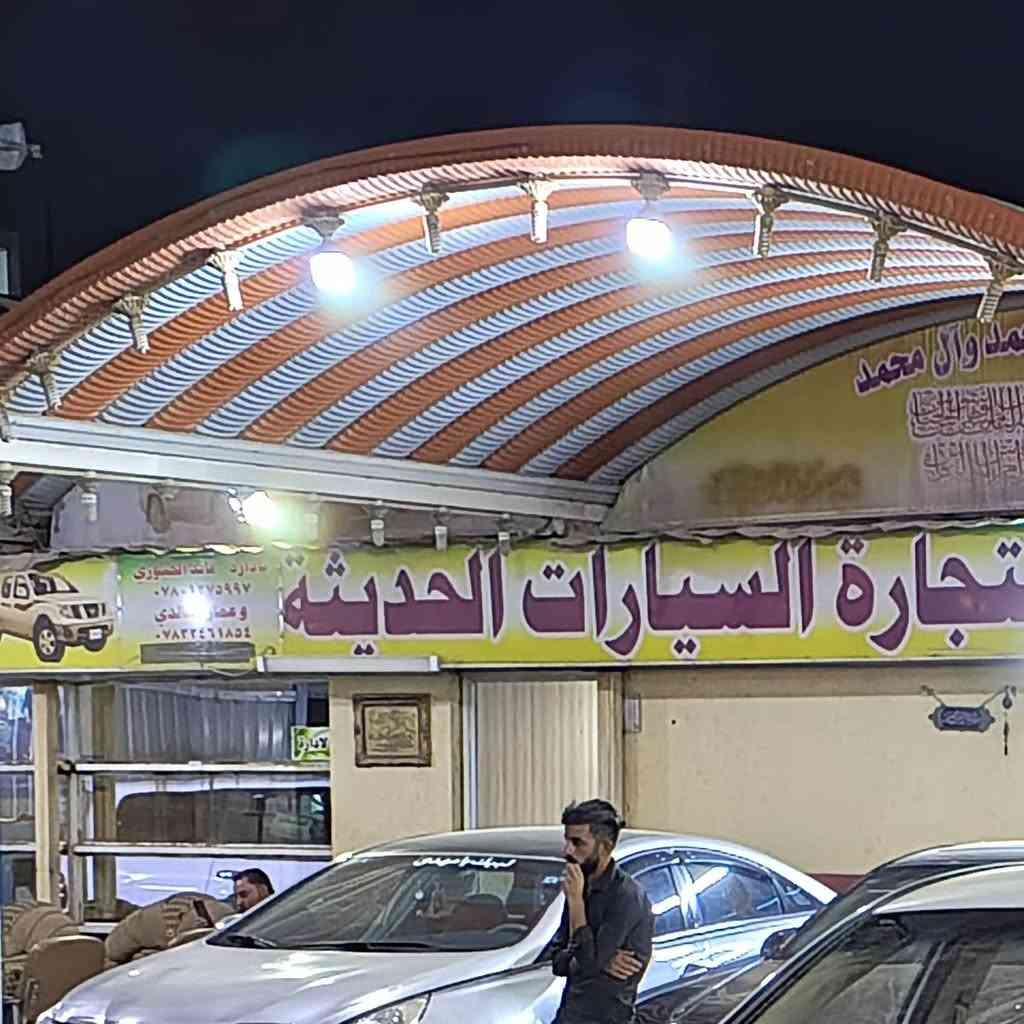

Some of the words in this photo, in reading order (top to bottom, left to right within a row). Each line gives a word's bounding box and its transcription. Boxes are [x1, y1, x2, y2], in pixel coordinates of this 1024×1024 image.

[855, 349, 925, 393] محمد
[283, 547, 504, 656] الحديثة
[522, 538, 815, 656] السيارات
